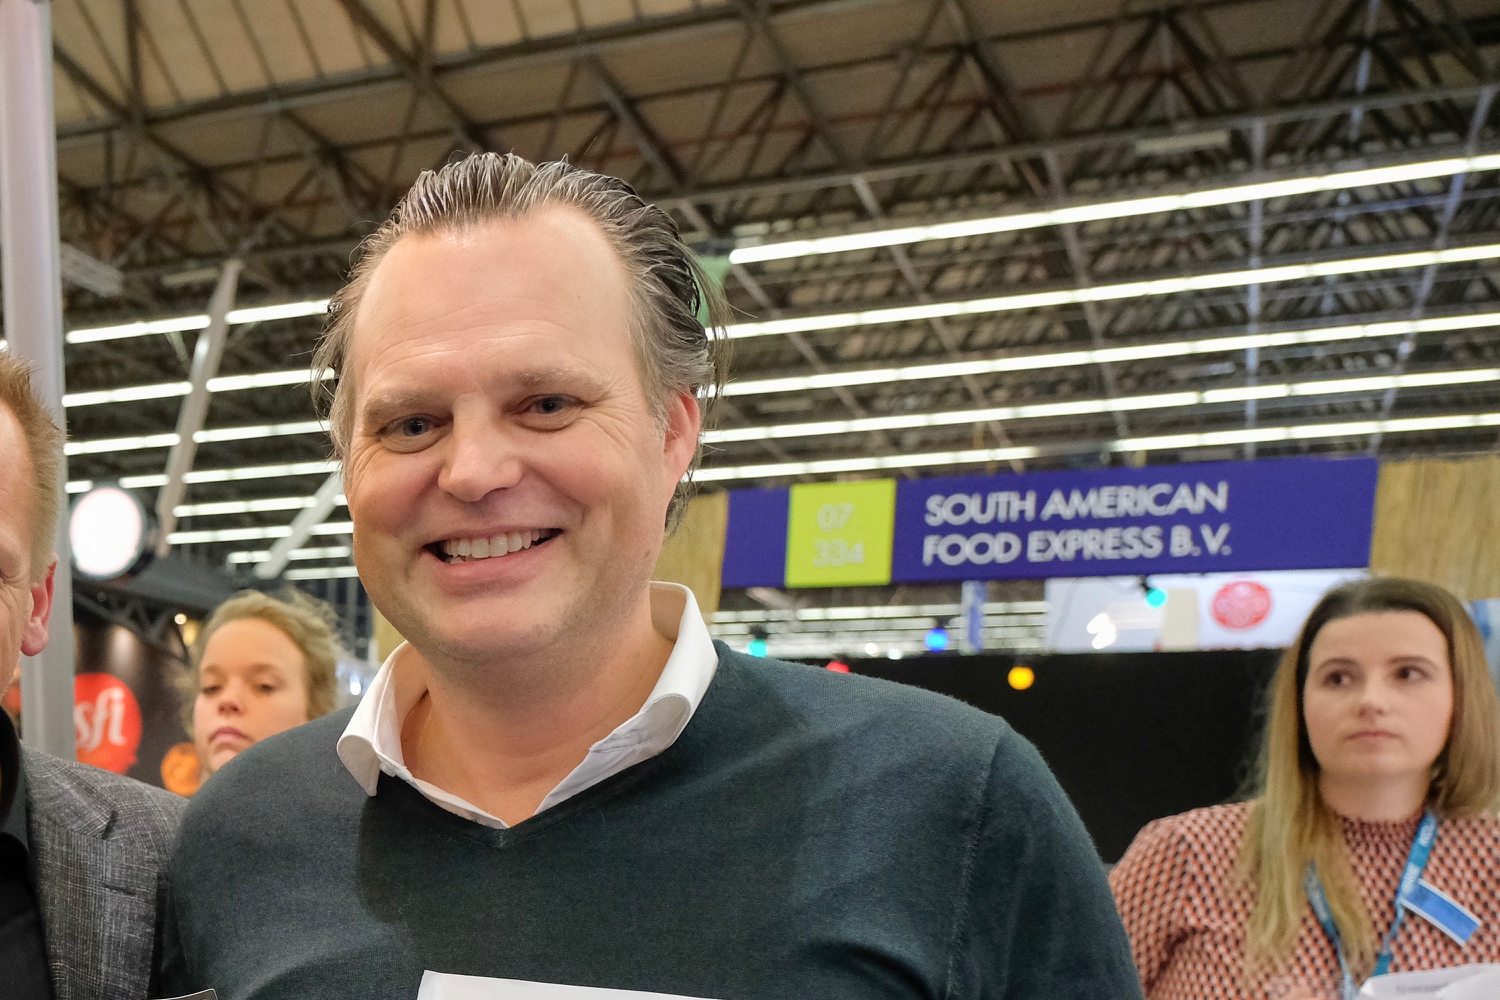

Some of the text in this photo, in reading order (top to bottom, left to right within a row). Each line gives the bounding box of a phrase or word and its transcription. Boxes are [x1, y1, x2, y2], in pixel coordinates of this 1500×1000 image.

[817, 503, 855, 532] 07
[924, 480, 1229, 526] SOUTH AMERICAN
[922, 531, 1022, 566] FOOD
[1027, 525, 1164, 562] EXPRESS
